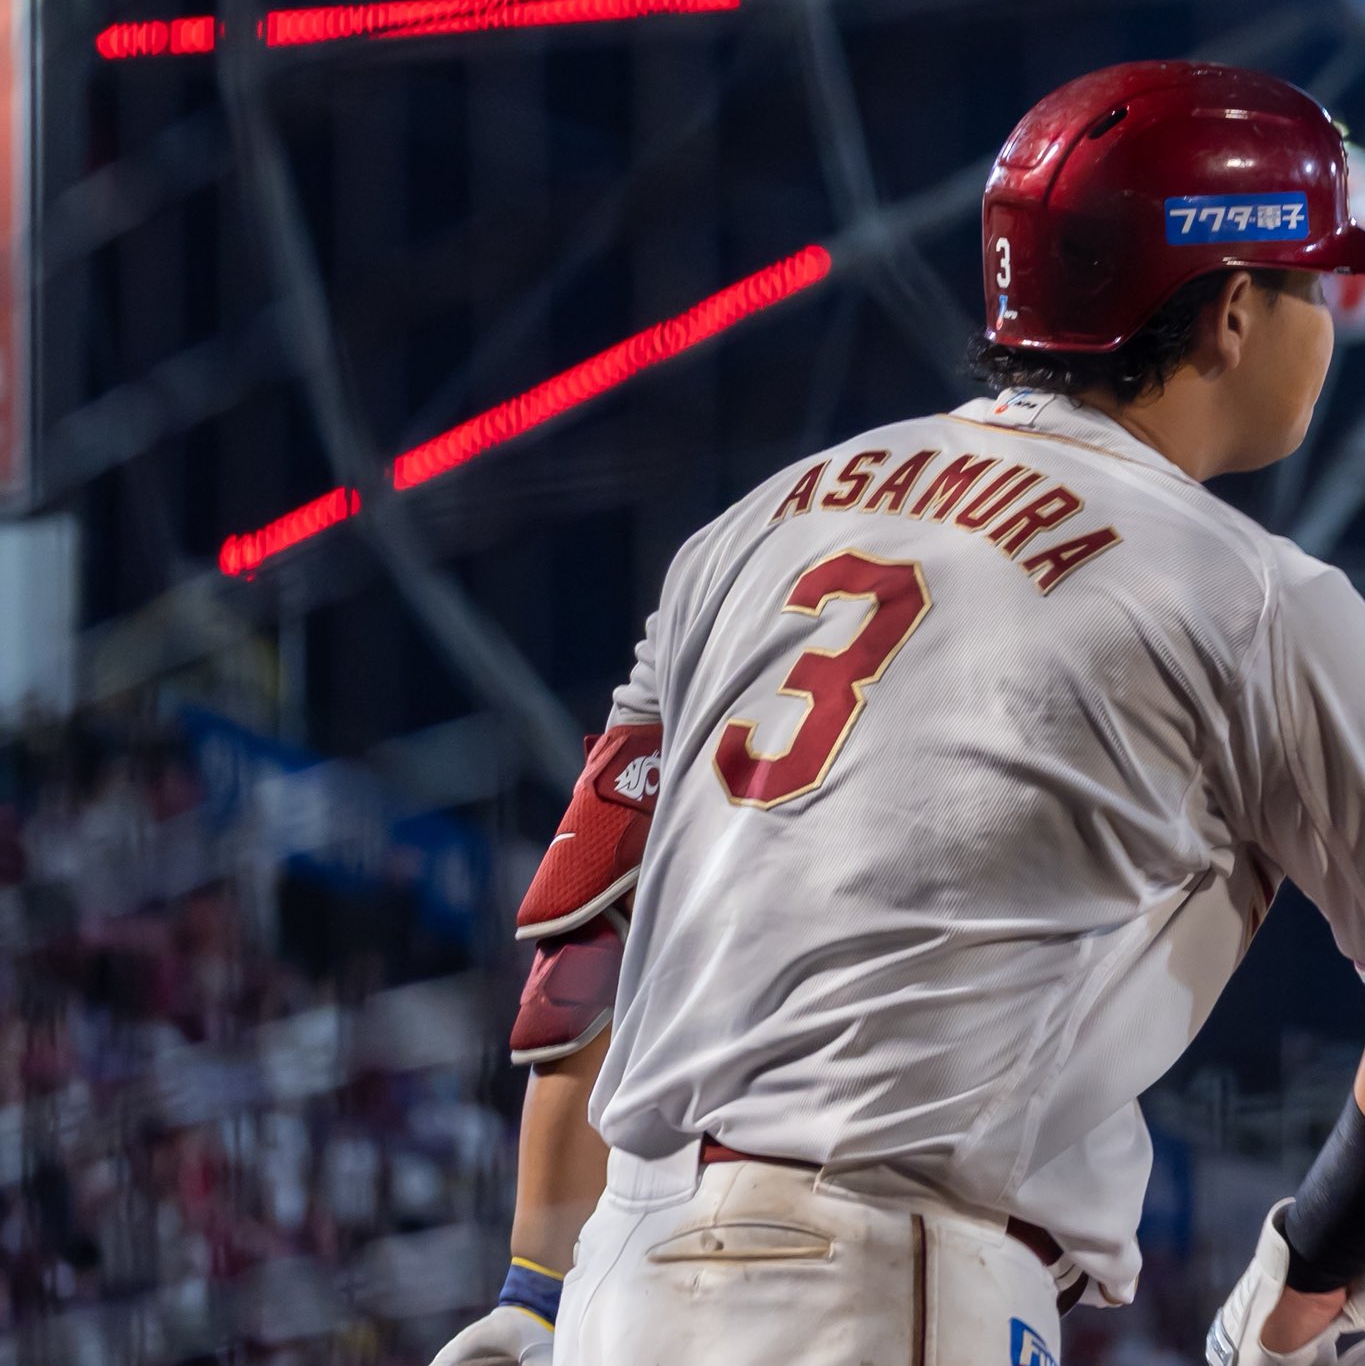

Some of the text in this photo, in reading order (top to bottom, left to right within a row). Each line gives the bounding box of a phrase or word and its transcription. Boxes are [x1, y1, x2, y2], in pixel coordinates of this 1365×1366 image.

[995, 236, 1012, 289] 3
[1169, 203, 1305, 234] フクダ電子
[767, 448, 1124, 597] ASAMURA
[711, 546, 934, 812] 3
